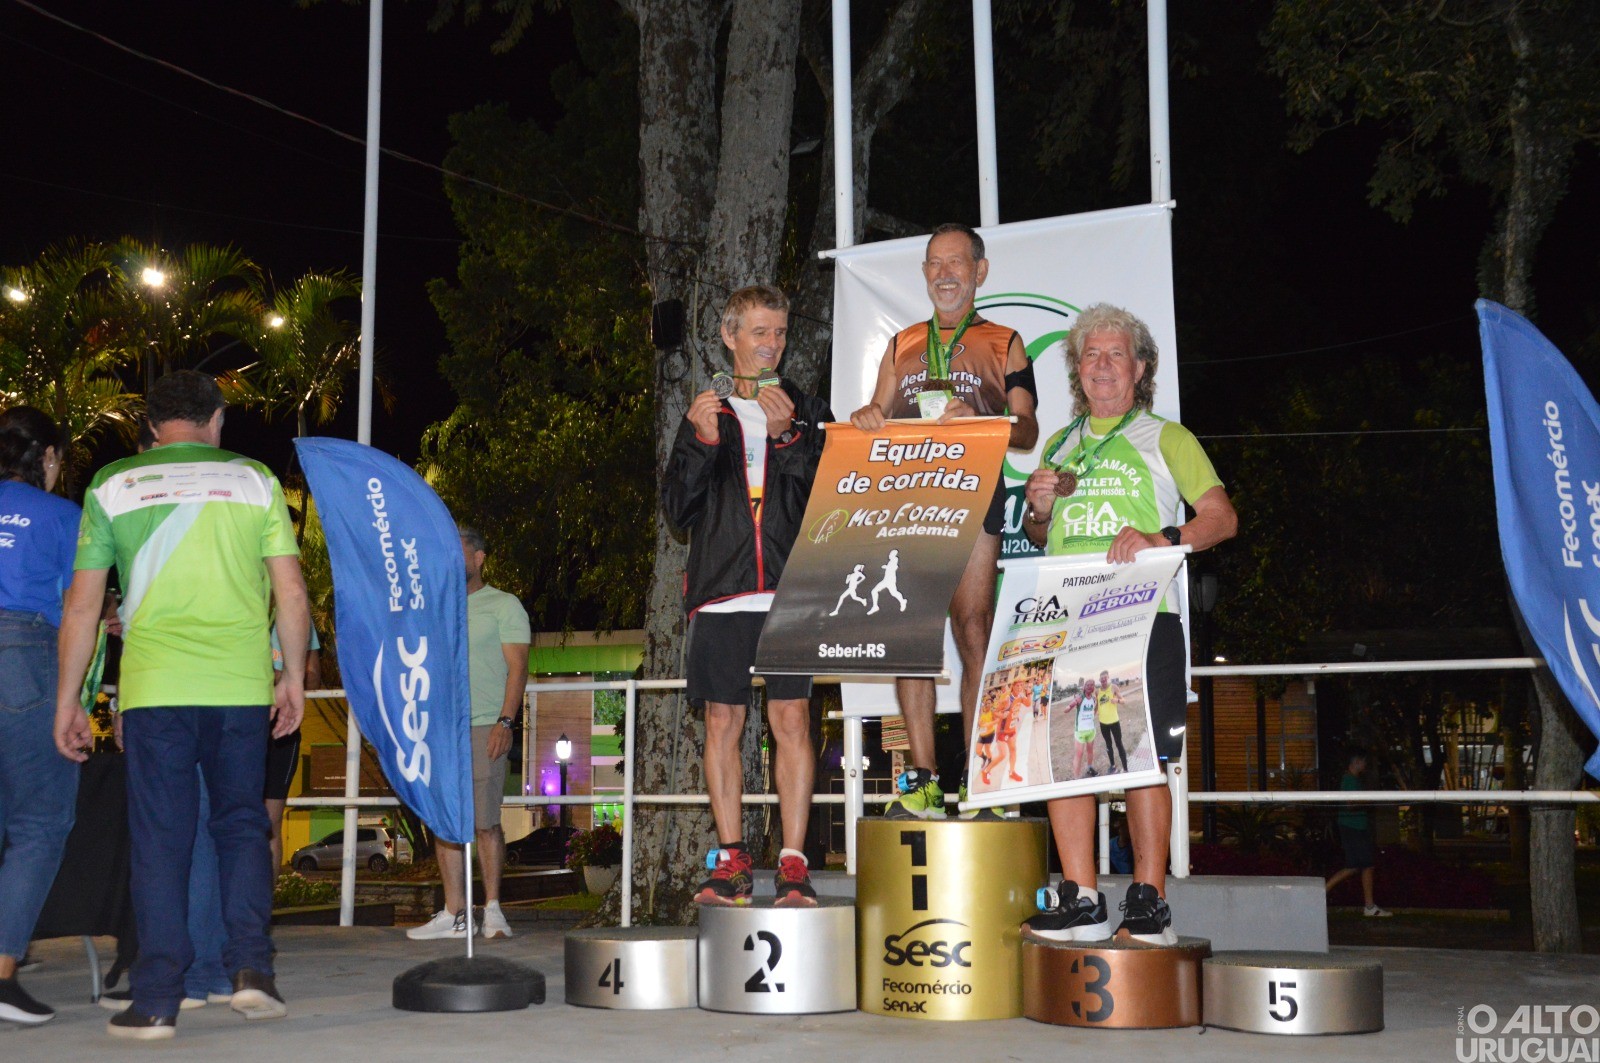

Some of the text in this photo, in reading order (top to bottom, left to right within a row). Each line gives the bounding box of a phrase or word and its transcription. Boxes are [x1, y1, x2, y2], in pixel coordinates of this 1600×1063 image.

[899, 370, 927, 390] Med
[868, 438, 965, 466] Equipe
[837, 467, 980, 494] de corrida
[1077, 478, 1122, 487] ATLETA
[1543, 401, 1582, 568] Fecomércio
[892, 503, 970, 524] FORMA
[1062, 501, 1119, 522] CIA
[366, 477, 403, 612] Fecomércio
[876, 524, 959, 538] Academia
[400, 537, 424, 610] Senac
[1082, 590, 1152, 616] DEBONI
[1089, 581, 1157, 601] eletro
[1012, 608, 1069, 624] TERRA
[818, 643, 885, 658] Seberi-RS
[396, 636, 432, 787] Sesc
[901, 831, 928, 911] 1
[743, 930, 786, 993] 2
[883, 932, 972, 967] Sesc
[598, 957, 624, 995] 4
[882, 978, 972, 995] Fecomércio
[1070, 954, 1115, 1022] 3
[883, 998, 927, 1013] Senac
[1268, 981, 1299, 1022] 5
